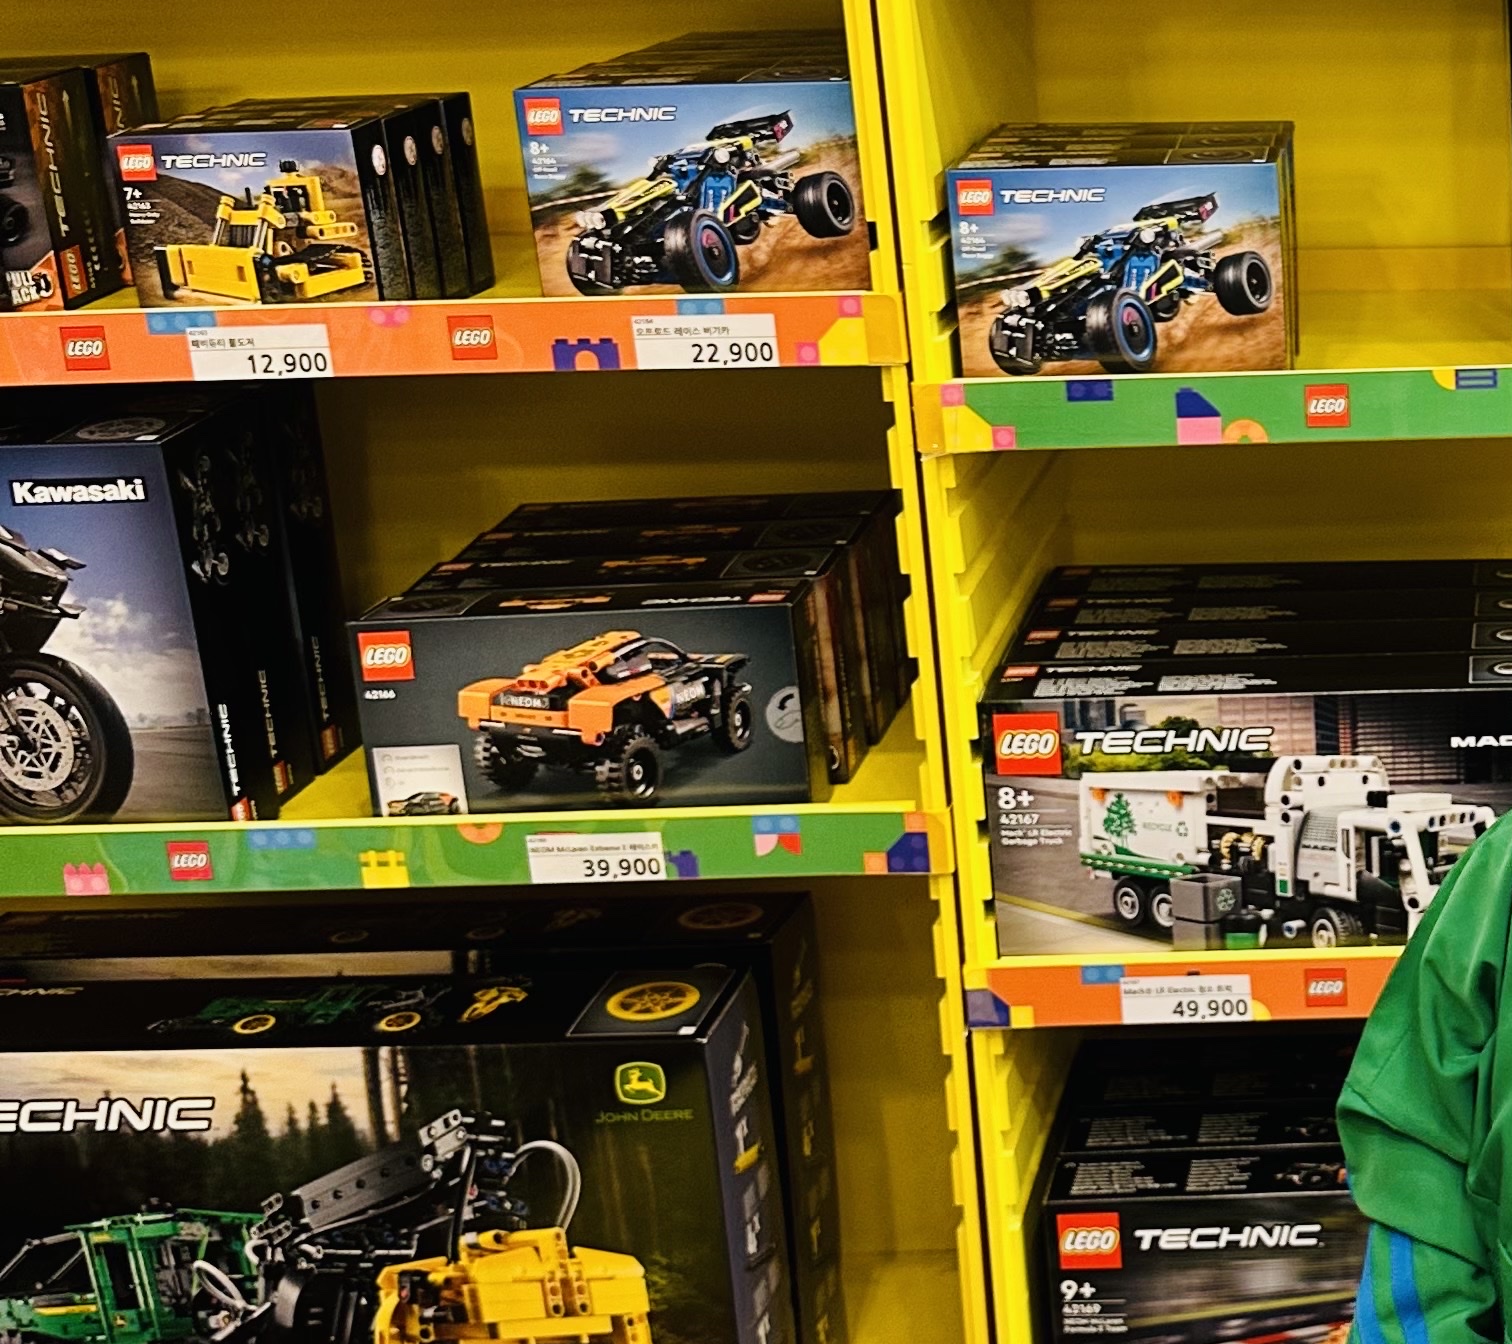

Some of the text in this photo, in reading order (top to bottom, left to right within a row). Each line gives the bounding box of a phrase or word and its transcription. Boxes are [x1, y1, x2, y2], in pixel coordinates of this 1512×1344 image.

[528, 109, 560, 125] LEGO
[568, 106, 677, 123] TECHNIC
[529, 141, 550, 156] 8+
[35, 92, 71, 238] TECHNIC
[121, 155, 152, 171] LEGO
[161, 152, 267, 170] TECHNIC
[123, 187, 143, 201] 7+
[960, 189, 992, 205] LEGO
[1000, 188, 1106, 204] TECHNIC
[959, 221, 979, 235] 8+
[453, 328, 492, 347] LEGO
[66, 338, 104, 358] LEGO
[691, 341, 774, 366] 22,900
[247, 352, 328, 377] 12,900
[1307, 398, 1347, 416] LEGO
[12, 478, 146, 504] Kawasaki
[365, 646, 408, 666] LEGO
[257, 669, 278, 759] TECHNIC
[217, 703, 242, 797] TECHNIC
[999, 731, 1057, 756] LEGO
[1075, 727, 1274, 755] TECHNIC
[997, 786, 1035, 810] 8+
[999, 813, 1041, 826] 42167
[171, 851, 208, 869] LEGO
[583, 857, 661, 879] 39,900
[1307, 979, 1345, 996] LEGO
[1173, 998, 1249, 1020] 49,900
[595, 1107, 694, 1123] JOHN DEERE
[1063, 1229, 1118, 1252] LEGO
[1134, 1223, 1322, 1251] TECHNIC
[1060, 1279, 1097, 1301] 9+
